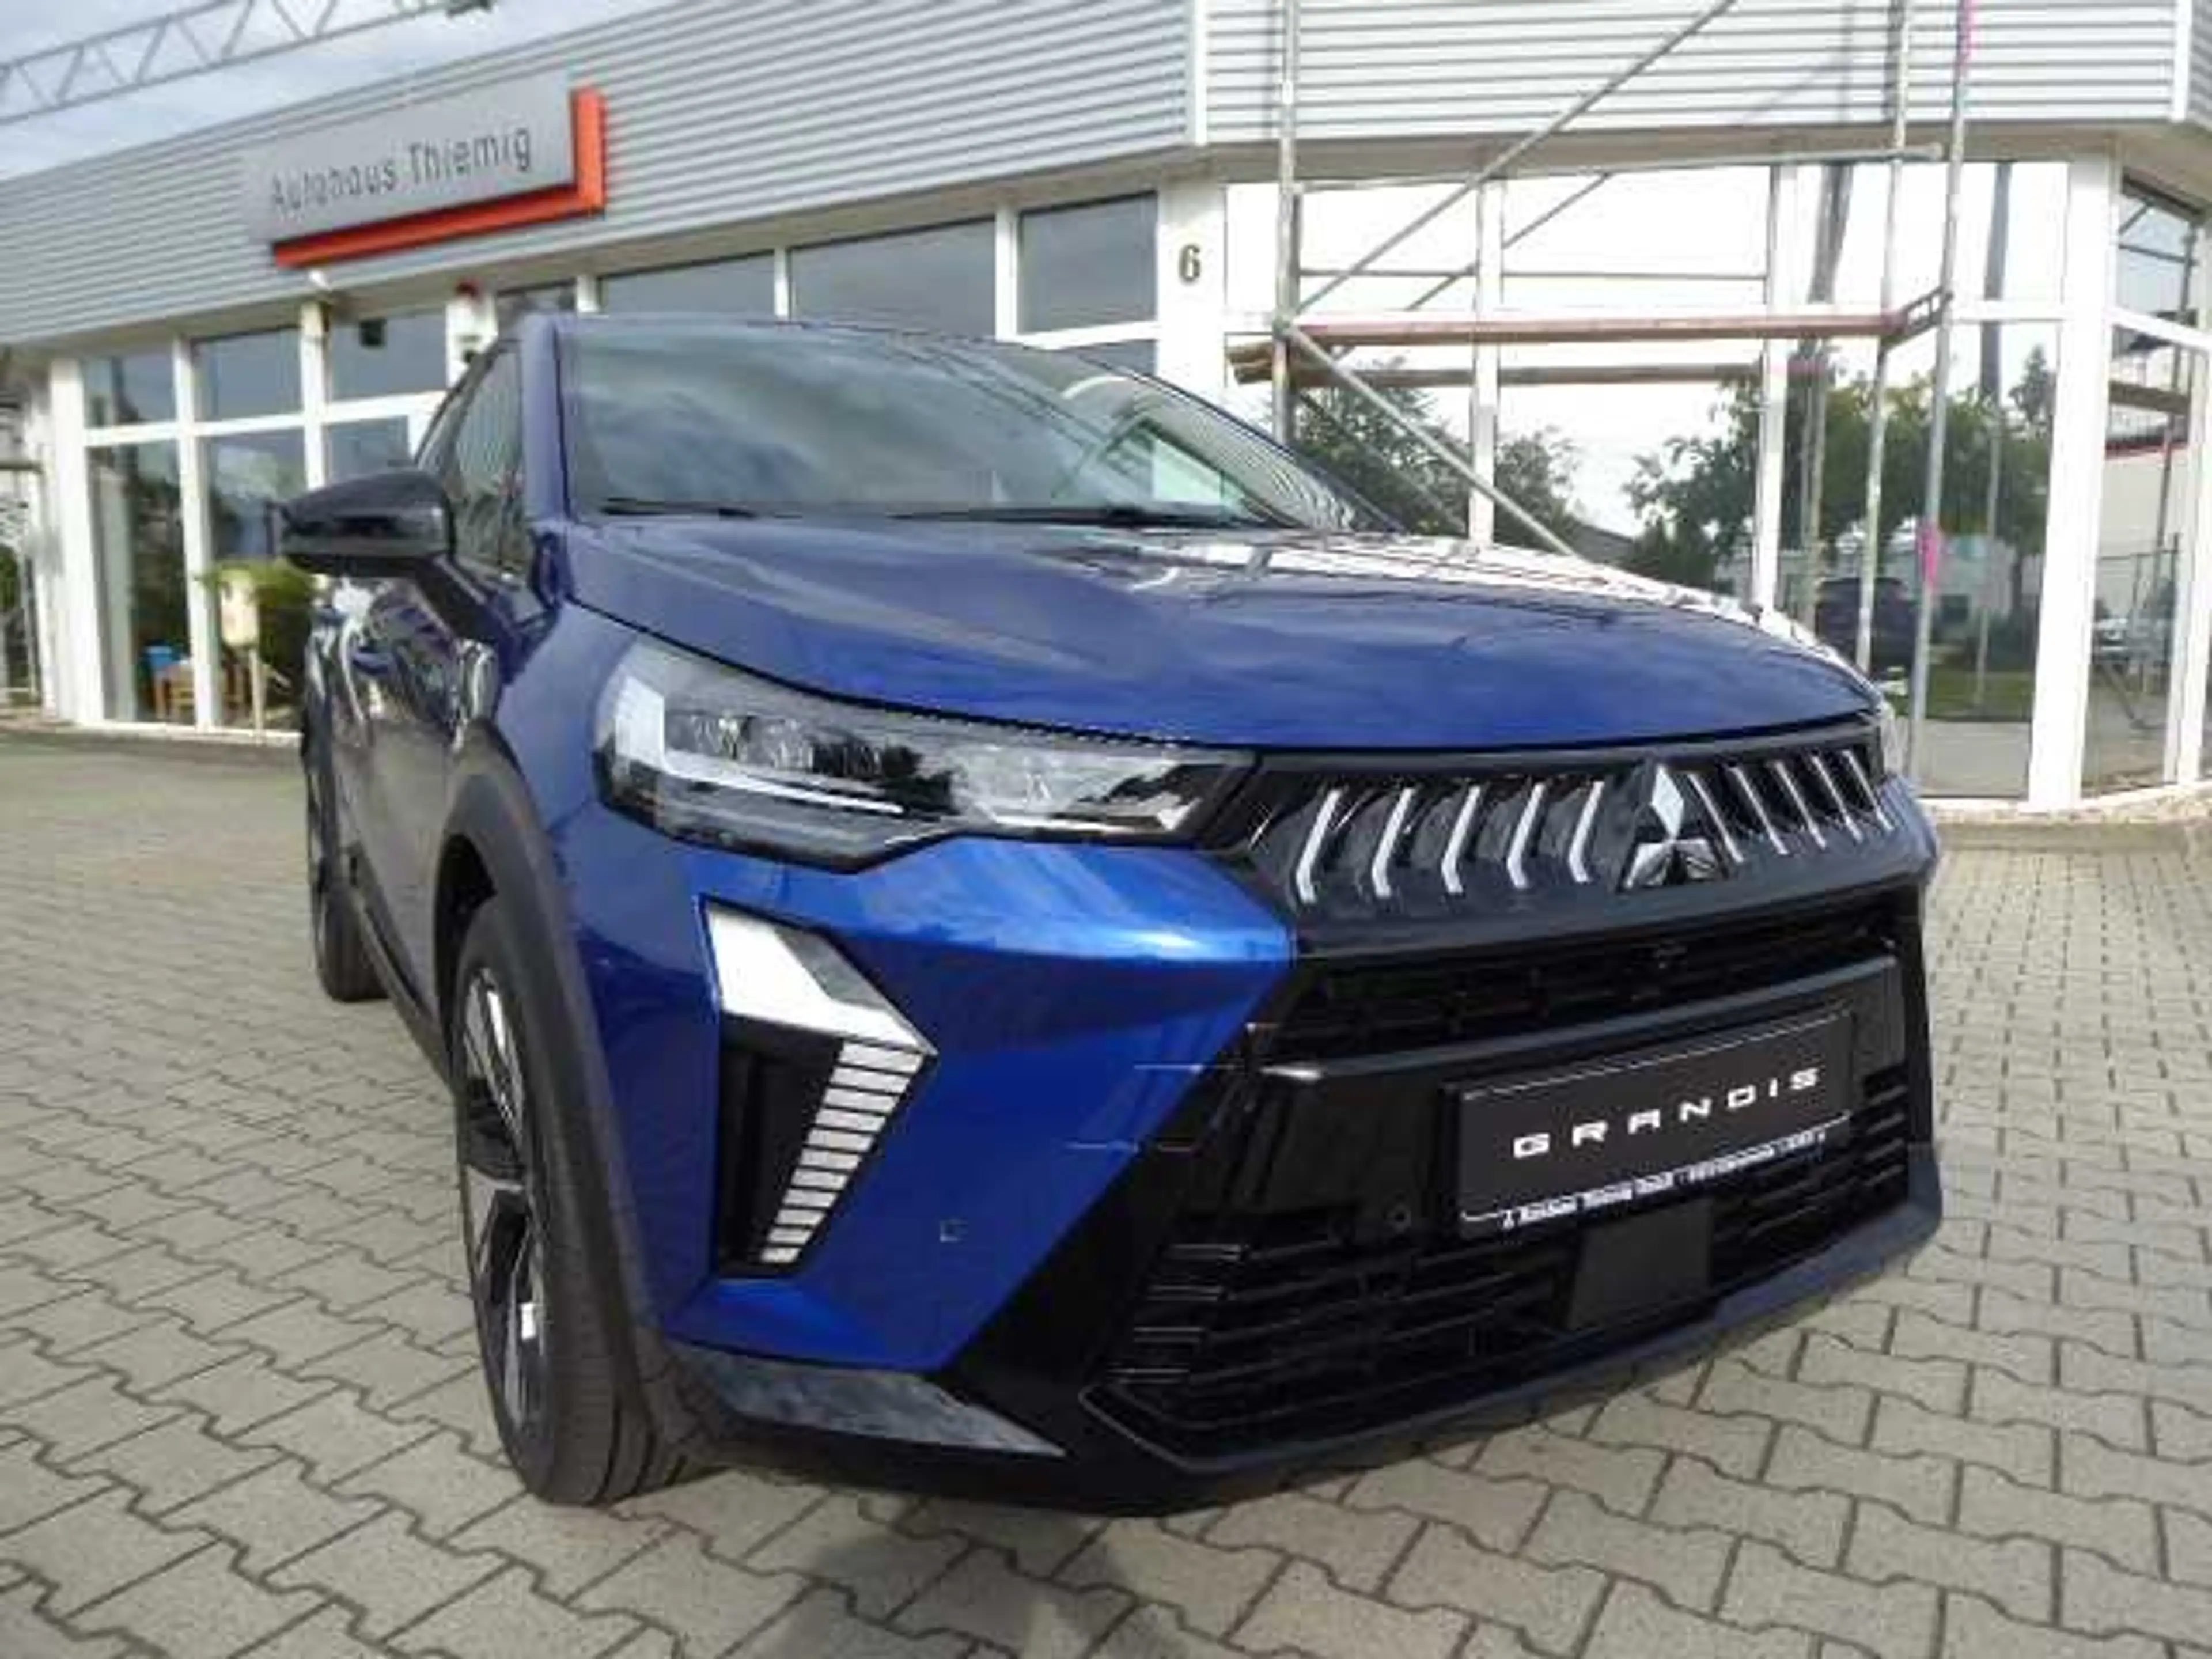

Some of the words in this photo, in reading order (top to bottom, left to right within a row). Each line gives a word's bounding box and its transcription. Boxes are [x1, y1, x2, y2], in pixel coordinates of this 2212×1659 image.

[271, 157, 397, 211] Autohaus
[408, 127, 531, 184] Thiemig
[1180, 243, 1201, 284] 6
[1513, 1066, 1820, 1159] GRANDIS
